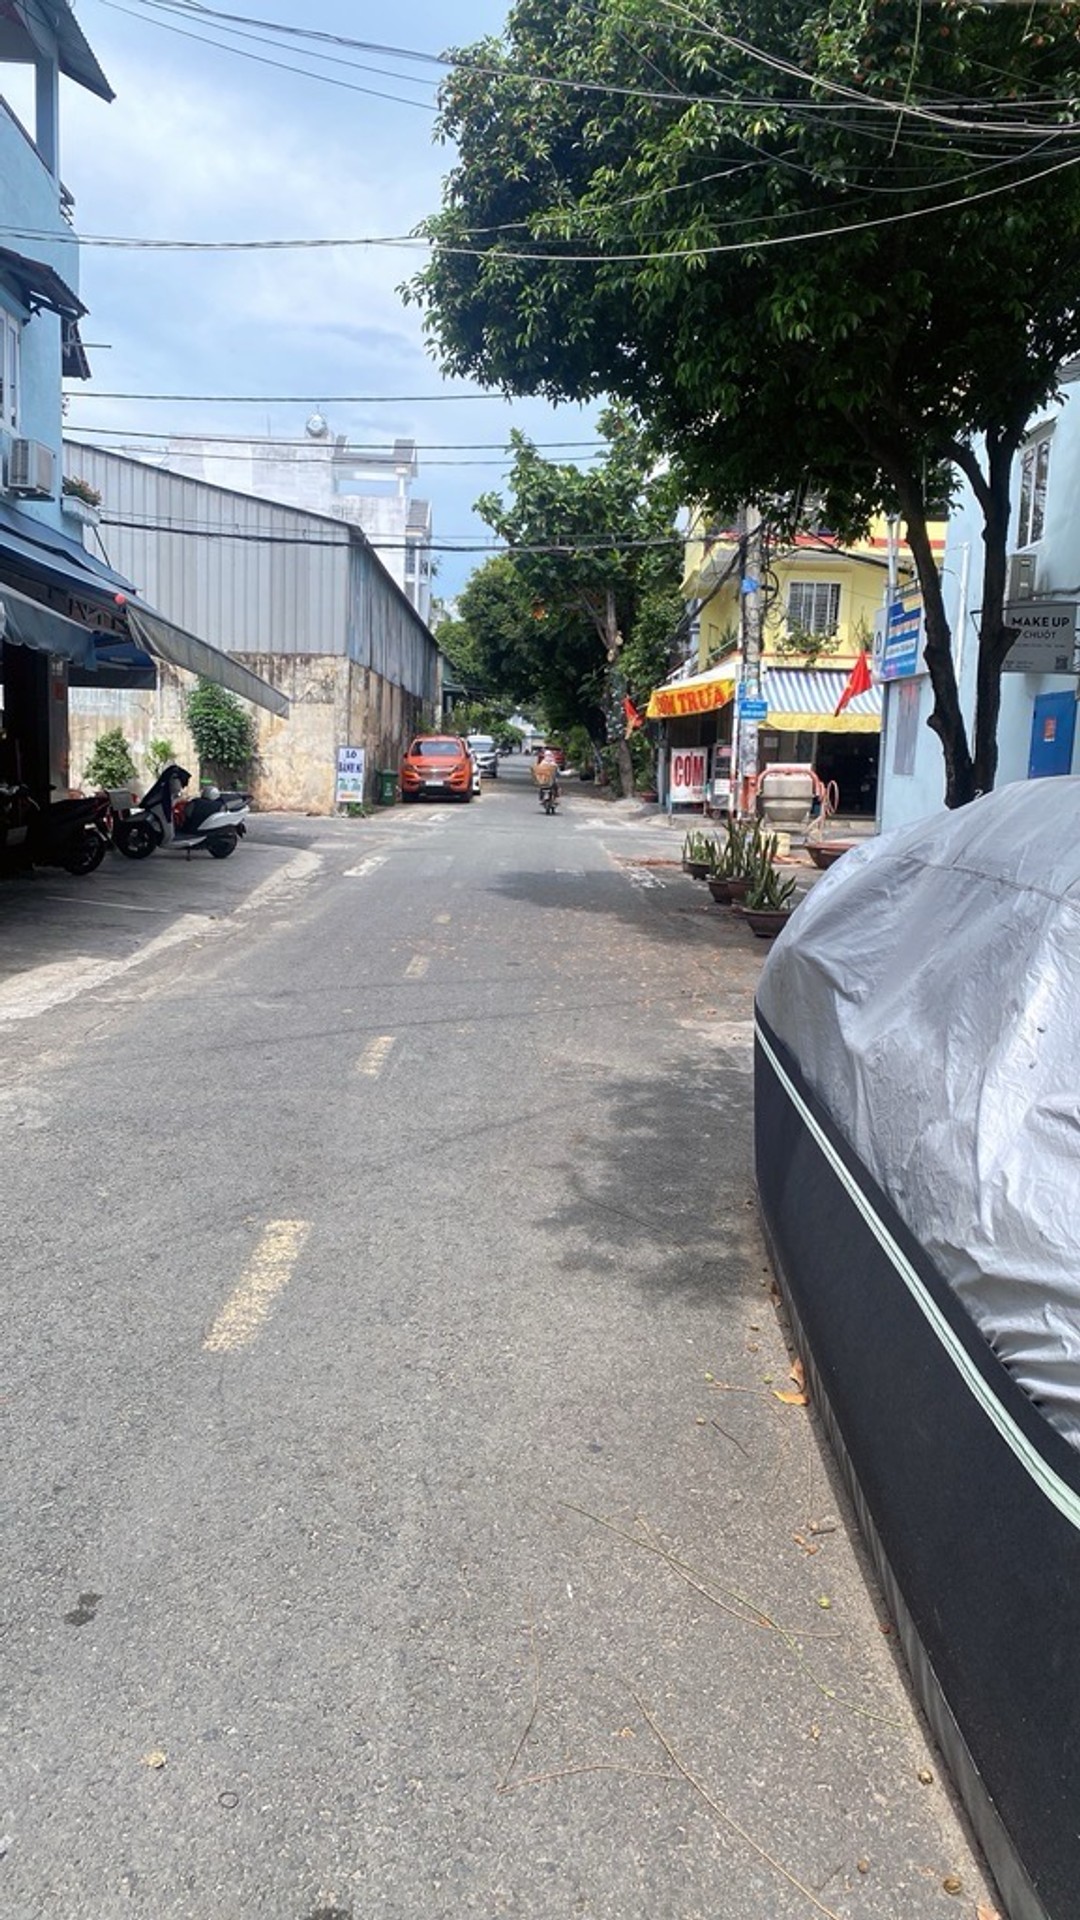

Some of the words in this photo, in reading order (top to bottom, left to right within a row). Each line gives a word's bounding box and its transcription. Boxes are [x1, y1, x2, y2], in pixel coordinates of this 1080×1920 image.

[1012, 616, 1049, 628] MAKE
[1052, 617, 1070, 628] UP
[674, 752, 704, 787] CƠM
